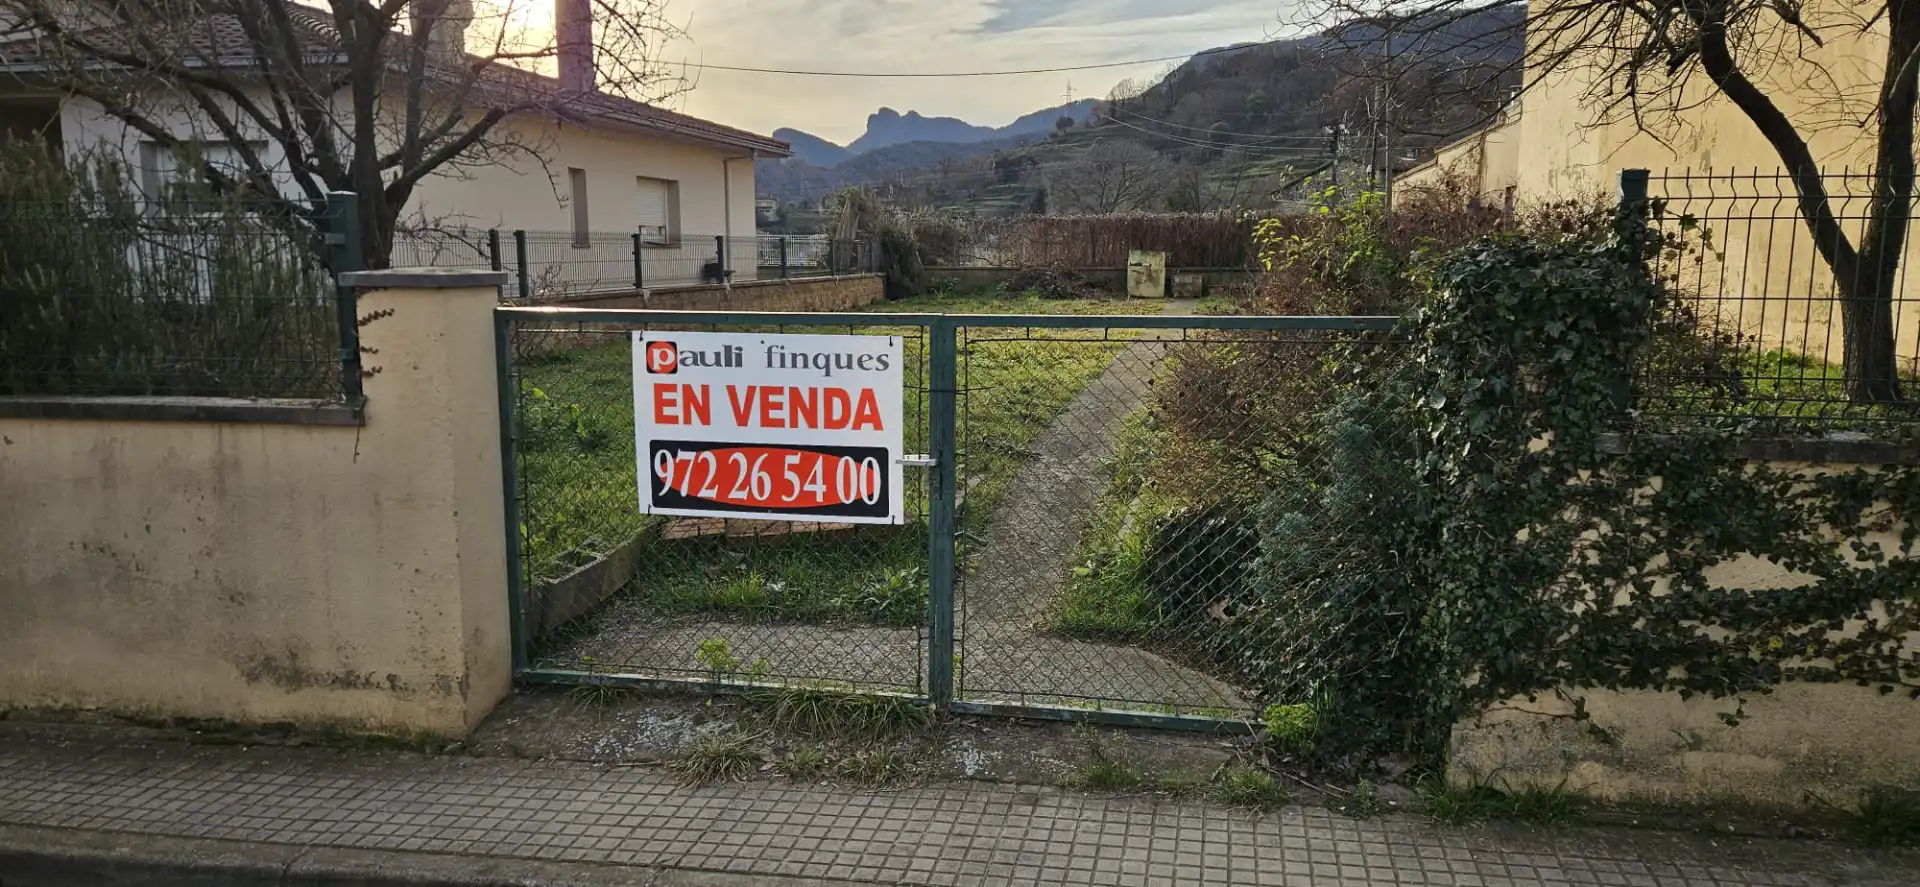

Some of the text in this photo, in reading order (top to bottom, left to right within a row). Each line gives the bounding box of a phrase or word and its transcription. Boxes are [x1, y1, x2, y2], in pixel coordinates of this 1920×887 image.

[765, 344, 889, 377] finques
[653, 383, 884, 431] EN VENDA
[654, 448, 881, 505] 972 26 54 00
